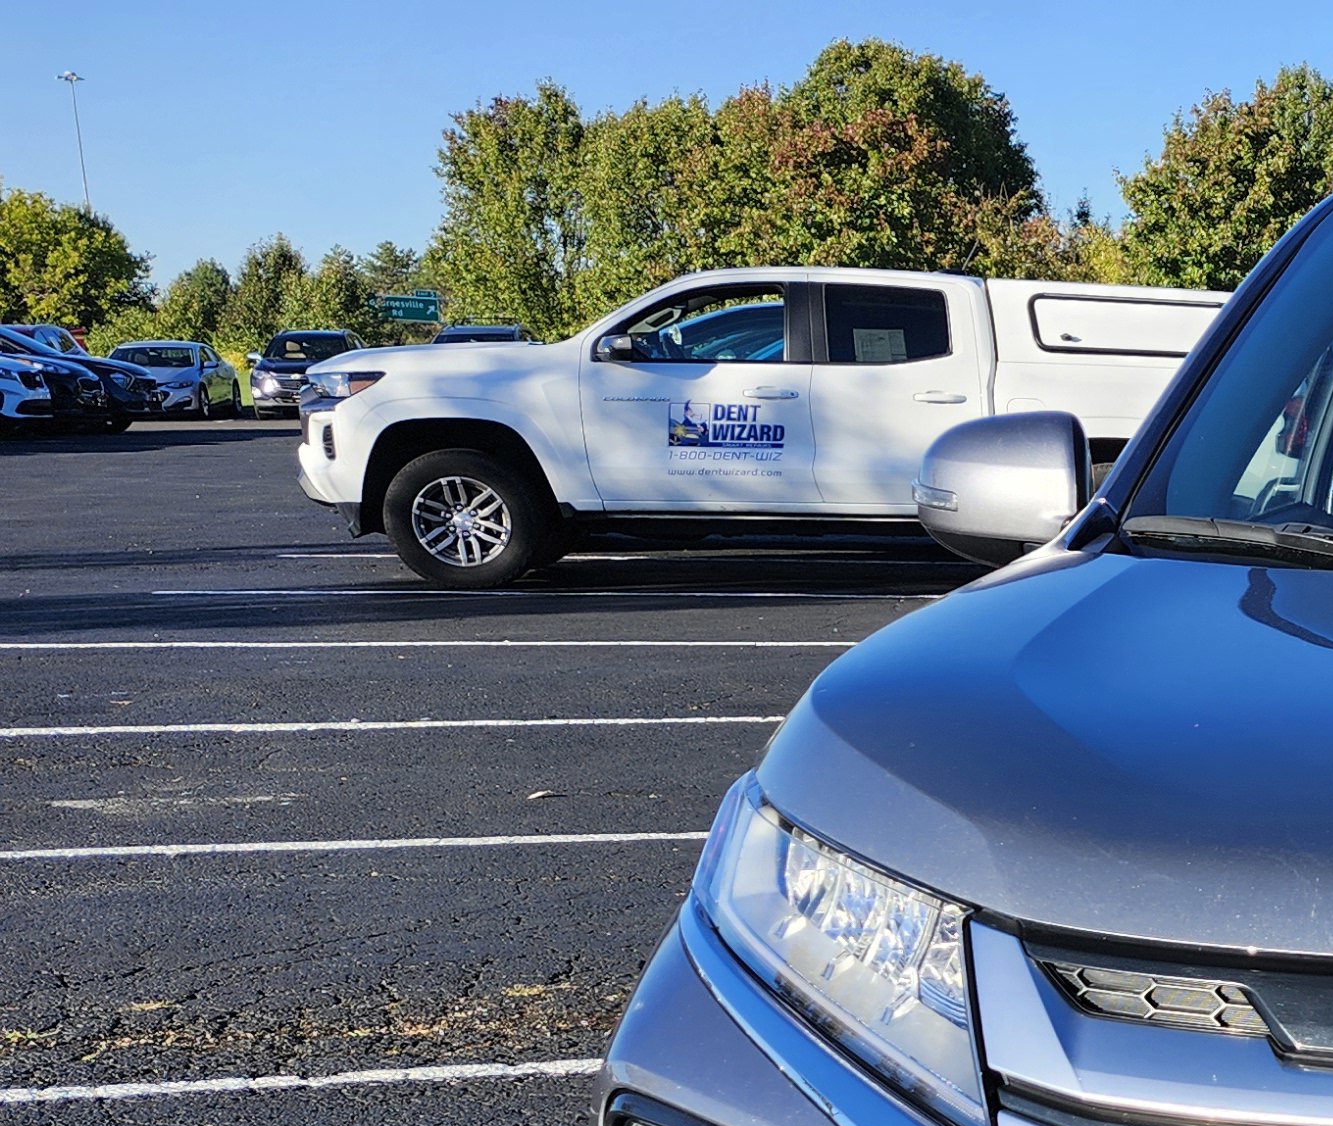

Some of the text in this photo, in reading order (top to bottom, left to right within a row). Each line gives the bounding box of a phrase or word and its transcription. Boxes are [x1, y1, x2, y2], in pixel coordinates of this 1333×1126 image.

[713, 404, 761, 422] DENT
[712, 423, 785, 442] WIZARD
[668, 450, 783, 461] 1-800-DENT-WIZ
[667, 468, 783, 477] www.dentwizard.com
